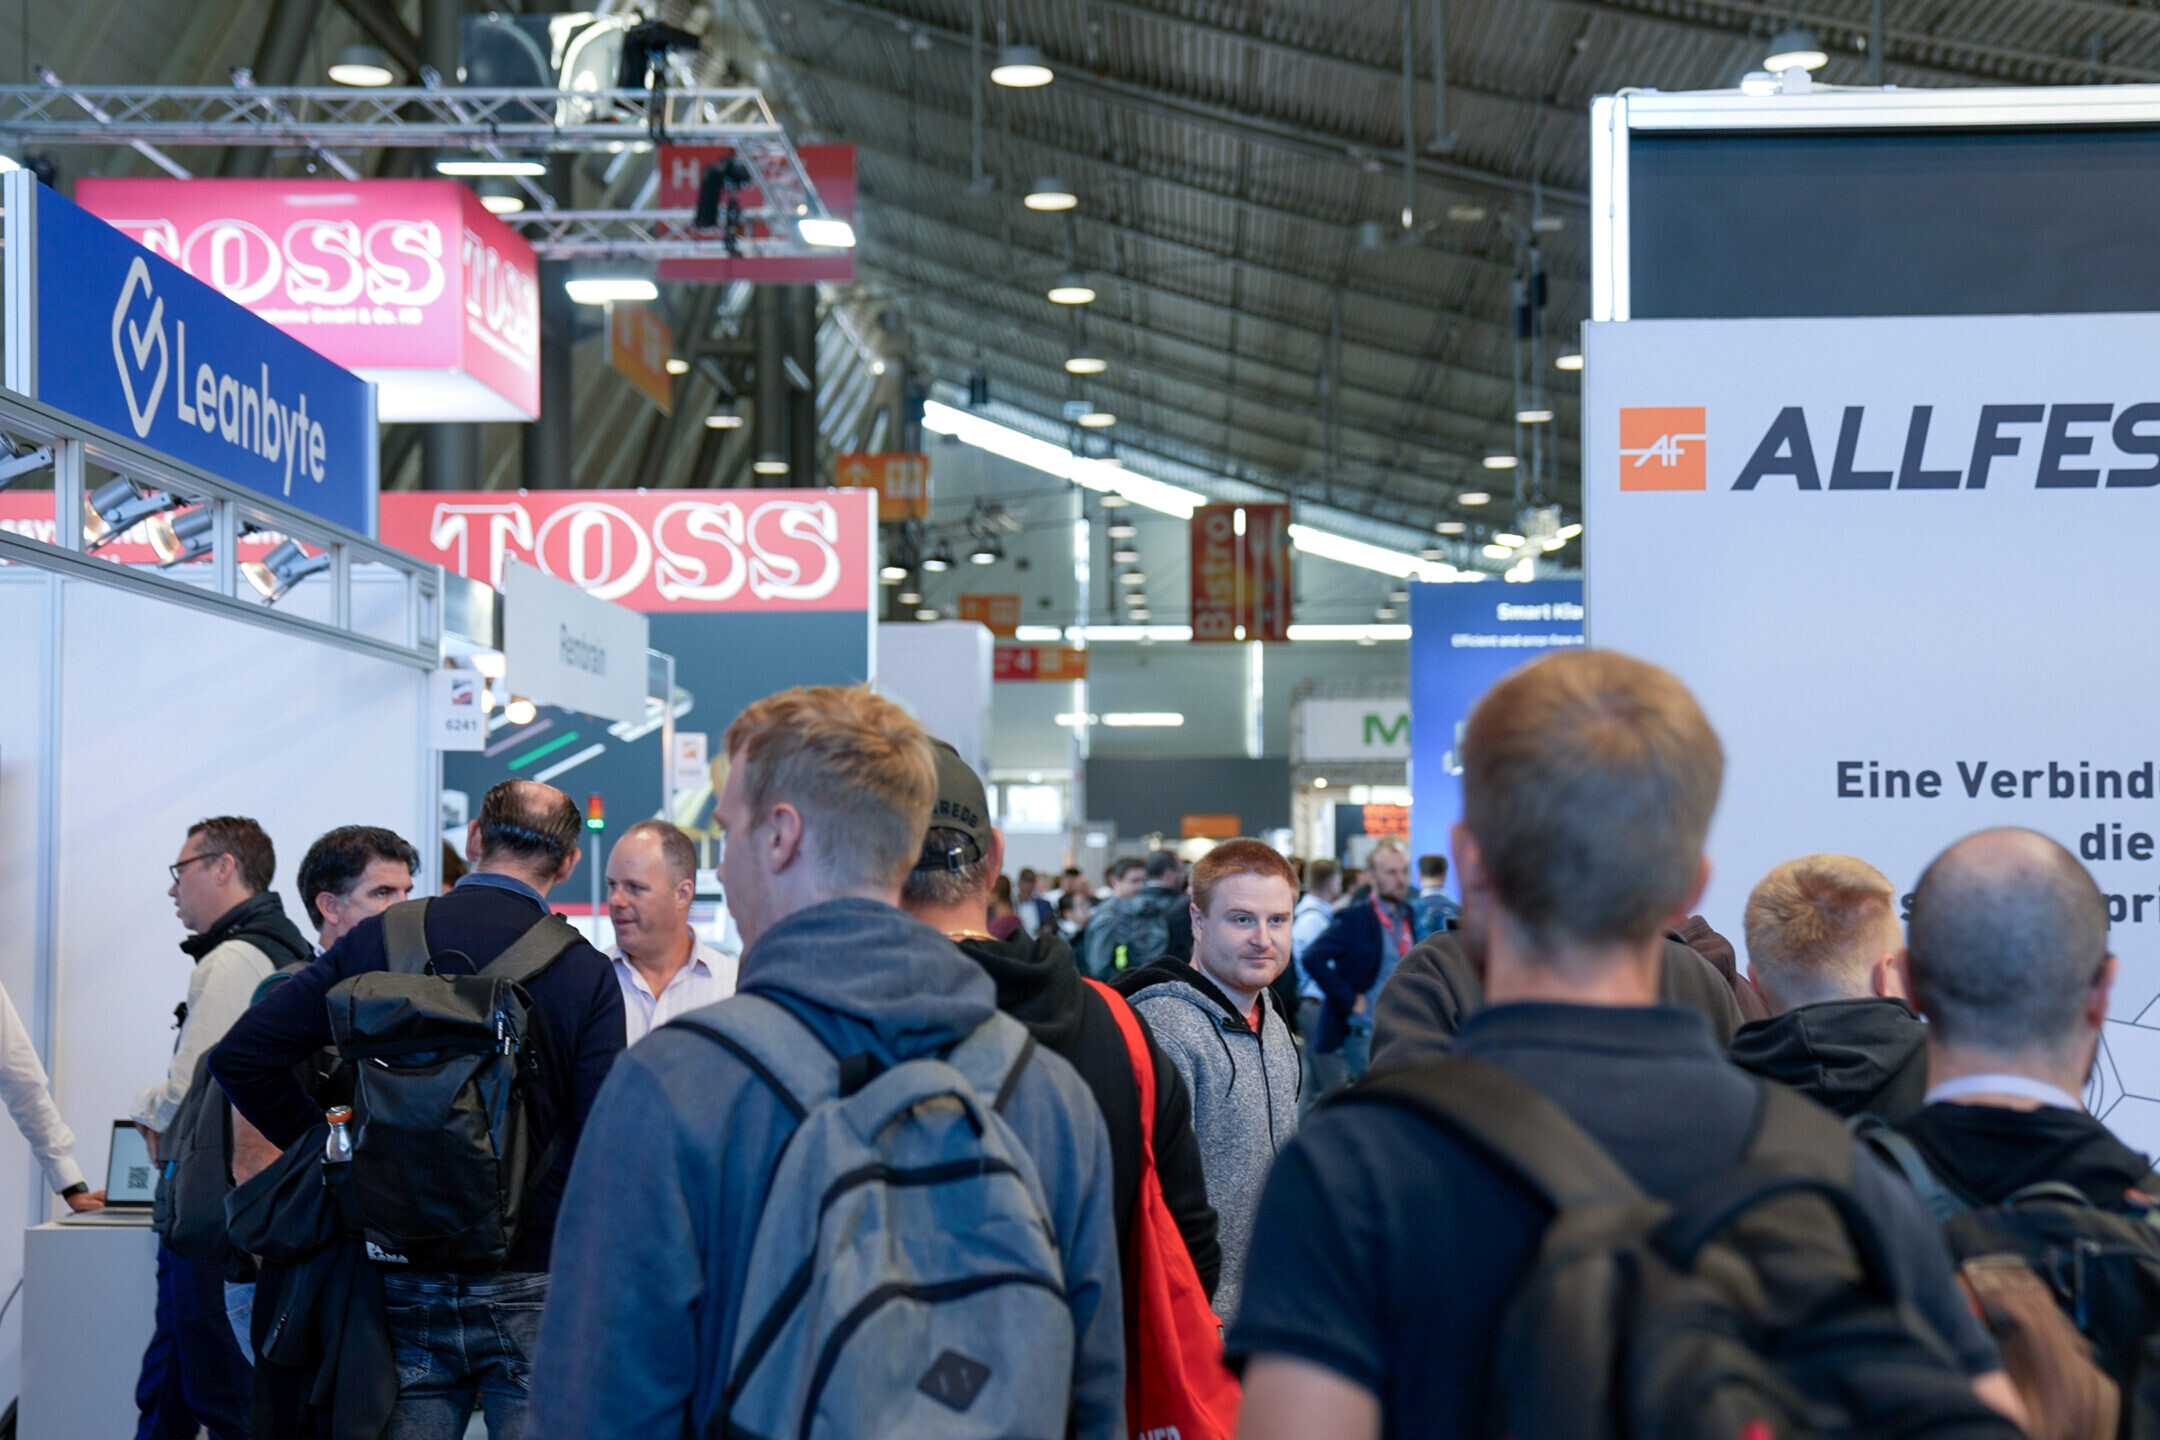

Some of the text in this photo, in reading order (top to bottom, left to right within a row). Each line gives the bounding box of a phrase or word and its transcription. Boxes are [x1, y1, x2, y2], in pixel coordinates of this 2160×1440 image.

[177, 319, 326, 497] Leanbyte
[430, 501, 841, 601] TOSS
[1195, 512, 1232, 638] Bistro
[1837, 761, 2160, 798] Eine Verbind
[2080, 823, 2154, 861] die
